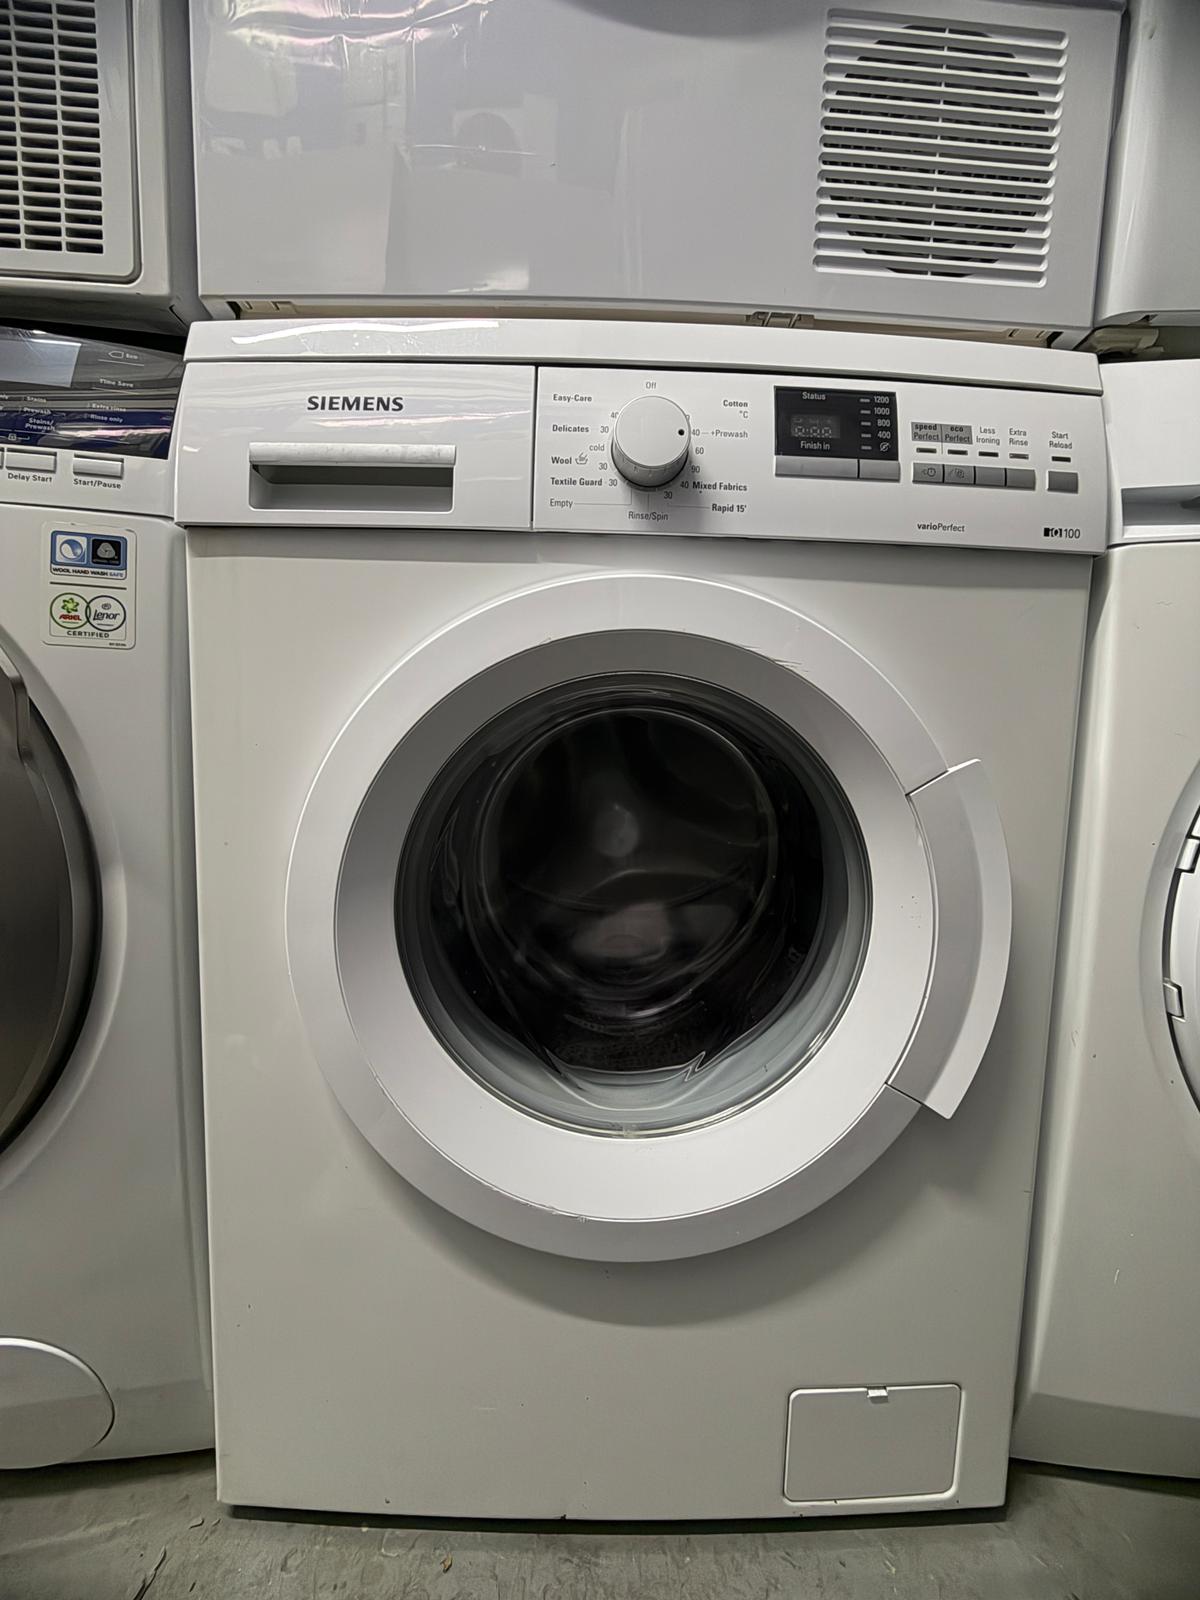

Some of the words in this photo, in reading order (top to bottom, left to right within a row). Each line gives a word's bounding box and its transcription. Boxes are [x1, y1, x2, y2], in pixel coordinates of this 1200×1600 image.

[646, 381, 656, 389] Off
[553, 394, 592, 403] Easy-Care
[802, 392, 826, 400] Status
[874, 396, 889, 404] 1200
[307, 396, 404, 411] SIEMENS
[723, 400, 748, 408] Cotton
[874, 407, 890, 415] 1000
[877, 419, 890, 427] 800
[915, 423, 938, 432] speed
[552, 424, 590, 433] Delicates
[600, 425, 609, 434] 30
[979, 426, 995, 435] Less
[1009, 428, 1027, 437] Extra
[877, 431, 891, 439] 400
[913, 432, 939, 441] Perfect
[945, 434, 970, 444] Perfect
[1051, 431, 1069, 440] Start
[800, 440, 822, 449] Finish
[823, 442, 831, 450] in
[976, 436, 1000, 446] Ironing
[1009, 437, 1029, 446] Rinse
[1049, 441, 1073, 450] Reload
[589, 444, 605, 452] cold
[695, 447, 704, 455] 60
[551, 456, 572, 465] Wool
[598, 462, 608, 471] 30
[691, 465, 701, 474] 90
[8, 473, 30, 482] Delay
[32, 475, 52, 483] Start
[550, 477, 577, 486] Textile
[578, 478, 603, 487] Guard
[608, 478, 618, 487] 30
[73, 479, 121, 489] Start/Pause
[680, 480, 690, 489] 40
[692, 481, 717, 490] Mixed
[718, 481, 748, 491] Fabrics
[663, 491, 673, 499] 30
[550, 499, 573, 509] Empty
[711, 503, 734, 513] Rapid
[628, 511, 669, 521] Rinse/Spin
[917, 523, 965, 532] varioPerfect
[59, 613, 82, 621] ARIEL
[93, 609, 120, 621] Lenor
[67, 630, 110, 638] CERTIFIED
